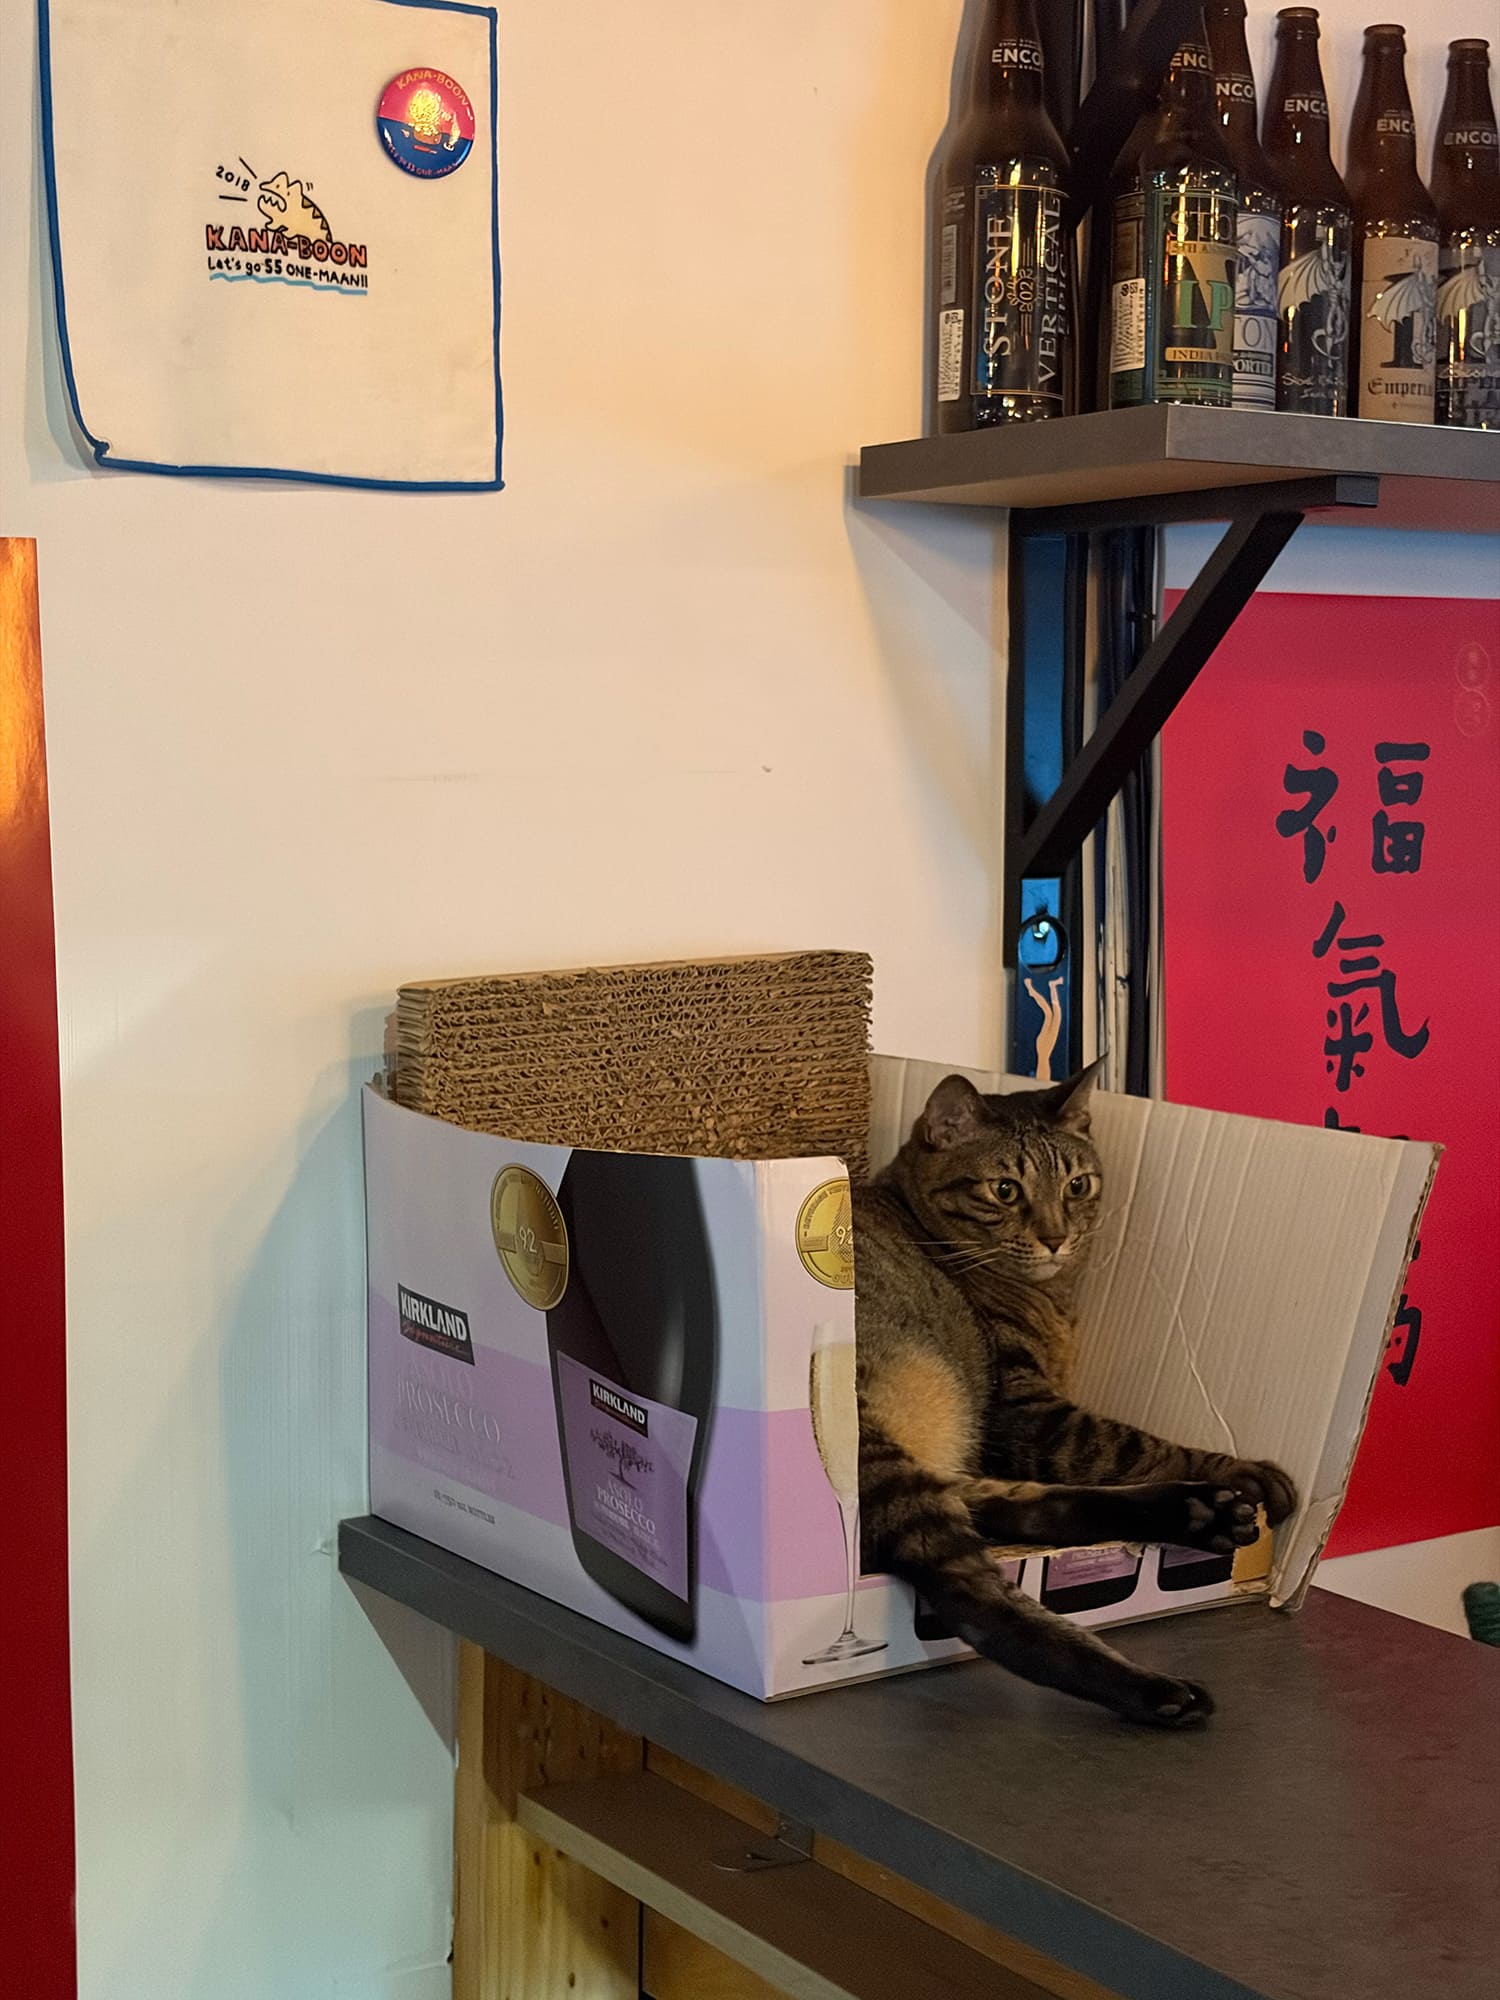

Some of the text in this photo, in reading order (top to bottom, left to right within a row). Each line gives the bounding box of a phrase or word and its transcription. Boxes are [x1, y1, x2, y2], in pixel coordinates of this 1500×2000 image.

[396, 70, 469, 106] KANA-BOON
[215, 165, 252, 192] 2018
[205, 224, 368, 268] KANA-BOON
[207, 256, 242, 271] Let's
[246, 262, 262, 276] go
[984, 214, 1014, 357] STONE
[519, 1226, 537, 1254] 92
[400, 1291, 468, 1342] KIRKLAND
[592, 1383, 646, 1424] KIRKLAND
[596, 1485, 657, 1535] PROSECCO
